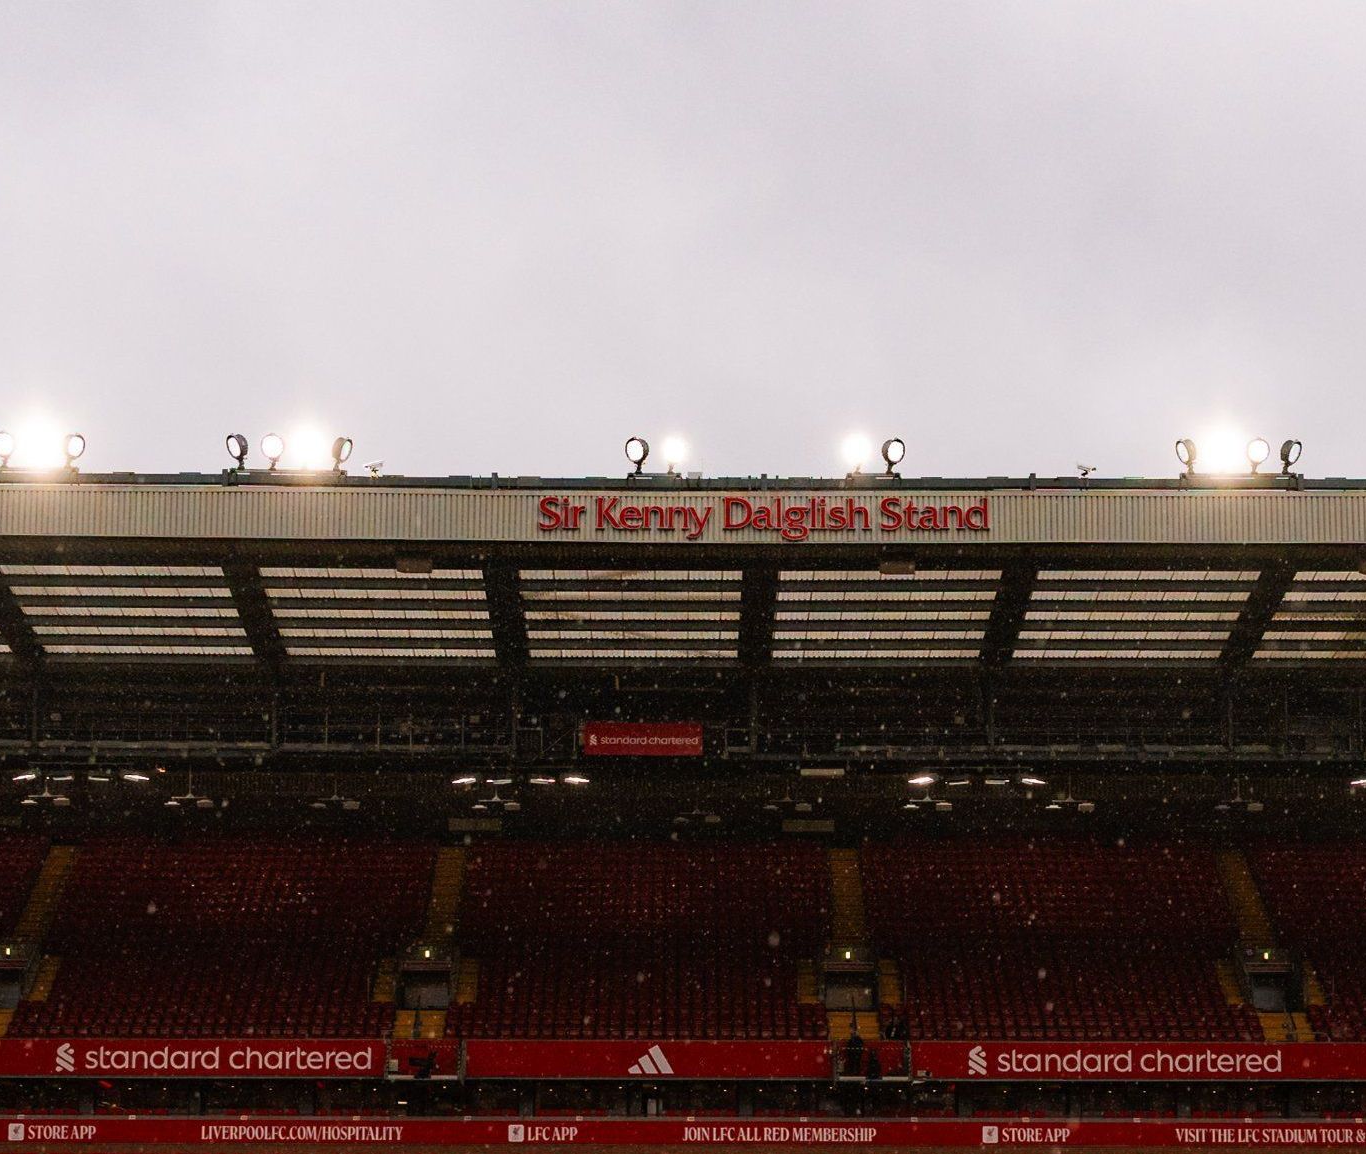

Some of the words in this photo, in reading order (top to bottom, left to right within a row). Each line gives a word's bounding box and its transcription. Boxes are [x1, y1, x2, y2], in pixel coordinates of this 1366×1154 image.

[538, 495, 586, 531] Sir
[595, 495, 714, 540] Kenny
[723, 495, 870, 540] Dalglish
[880, 497, 989, 530] Stand
[600, 735, 648, 745] standard
[648, 735, 700, 745] chartered
[85, 1046, 220, 1070] standard
[228, 1046, 372, 1070] chartered
[997, 1049, 1133, 1073] standard
[1139, 1049, 1282, 1073] chartered
[27, 1124, 69, 1140] STORE
[70, 1125, 97, 1140] APP
[201, 1125, 403, 1141] LIVERPOOLFC.COM/HOSPITALITY
[527, 1126, 550, 1142] LFC
[551, 1126, 578, 1141] APP
[682, 1126, 710, 1142] JOIN
[712, 1126, 736, 1142] LFC
[737, 1127, 762, 1142] ALL
[763, 1126, 790, 1142] RED
[792, 1127, 877, 1142] MEMBERSHIP
[1001, 1127, 1043, 1143] STORE
[1044, 1127, 1071, 1143] APP
[1175, 1128, 1208, 1143] VISIT
[1209, 1128, 1236, 1143] THE
[1237, 1128, 1260, 1143] LFC
[1262, 1128, 1318, 1144] STADIUM
[1319, 1128, 1354, 1144] TOUR
[1355, 1128, 1366, 1143] &
